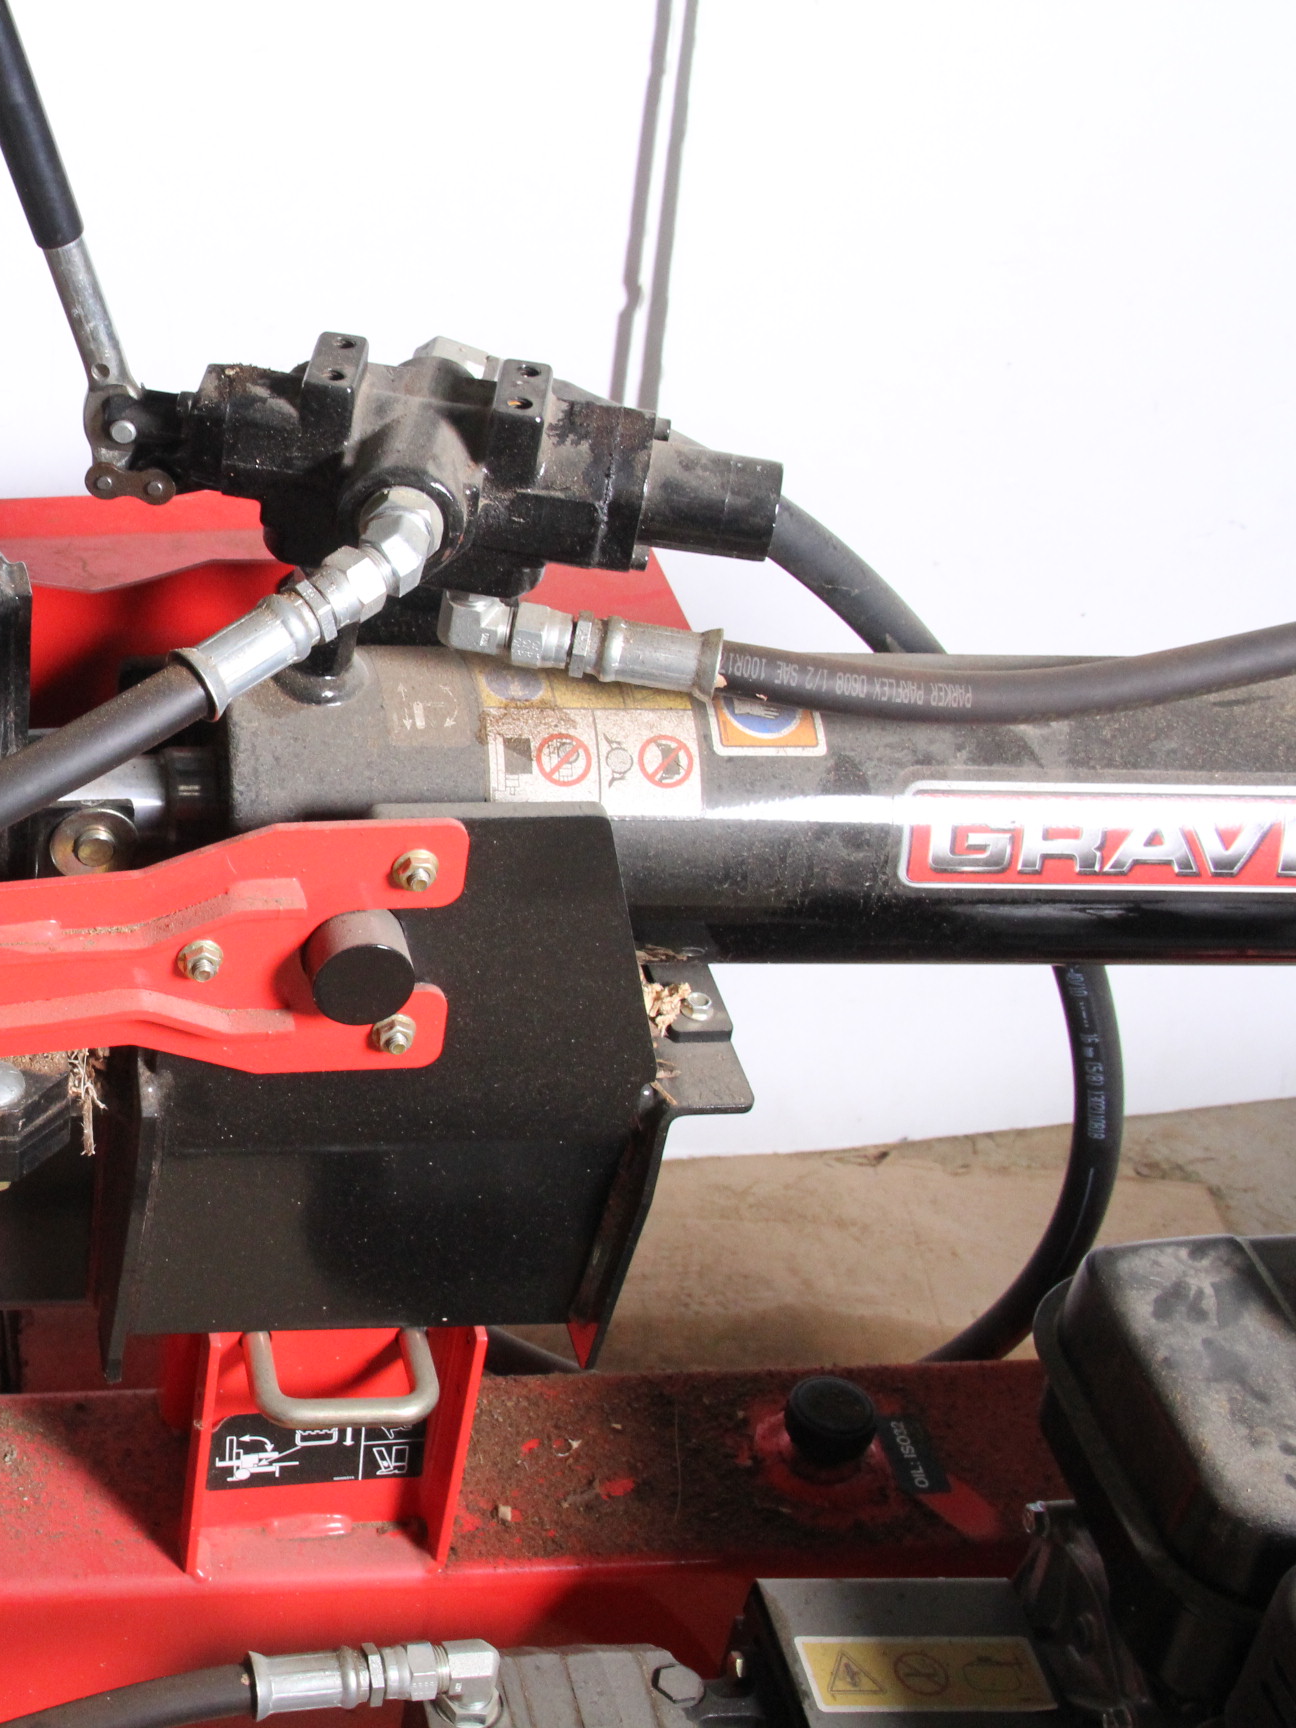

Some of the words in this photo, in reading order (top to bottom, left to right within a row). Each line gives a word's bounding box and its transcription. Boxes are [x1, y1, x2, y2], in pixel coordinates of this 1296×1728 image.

[774, 660, 799, 686] SAE
[805, 665, 828, 691] 1/2
[873, 676, 924, 704] PARFLEX
[930, 682, 973, 708] PARKER
[929, 803, 1296, 877] GRAV
[910, 1461, 929, 1488] OIL:
